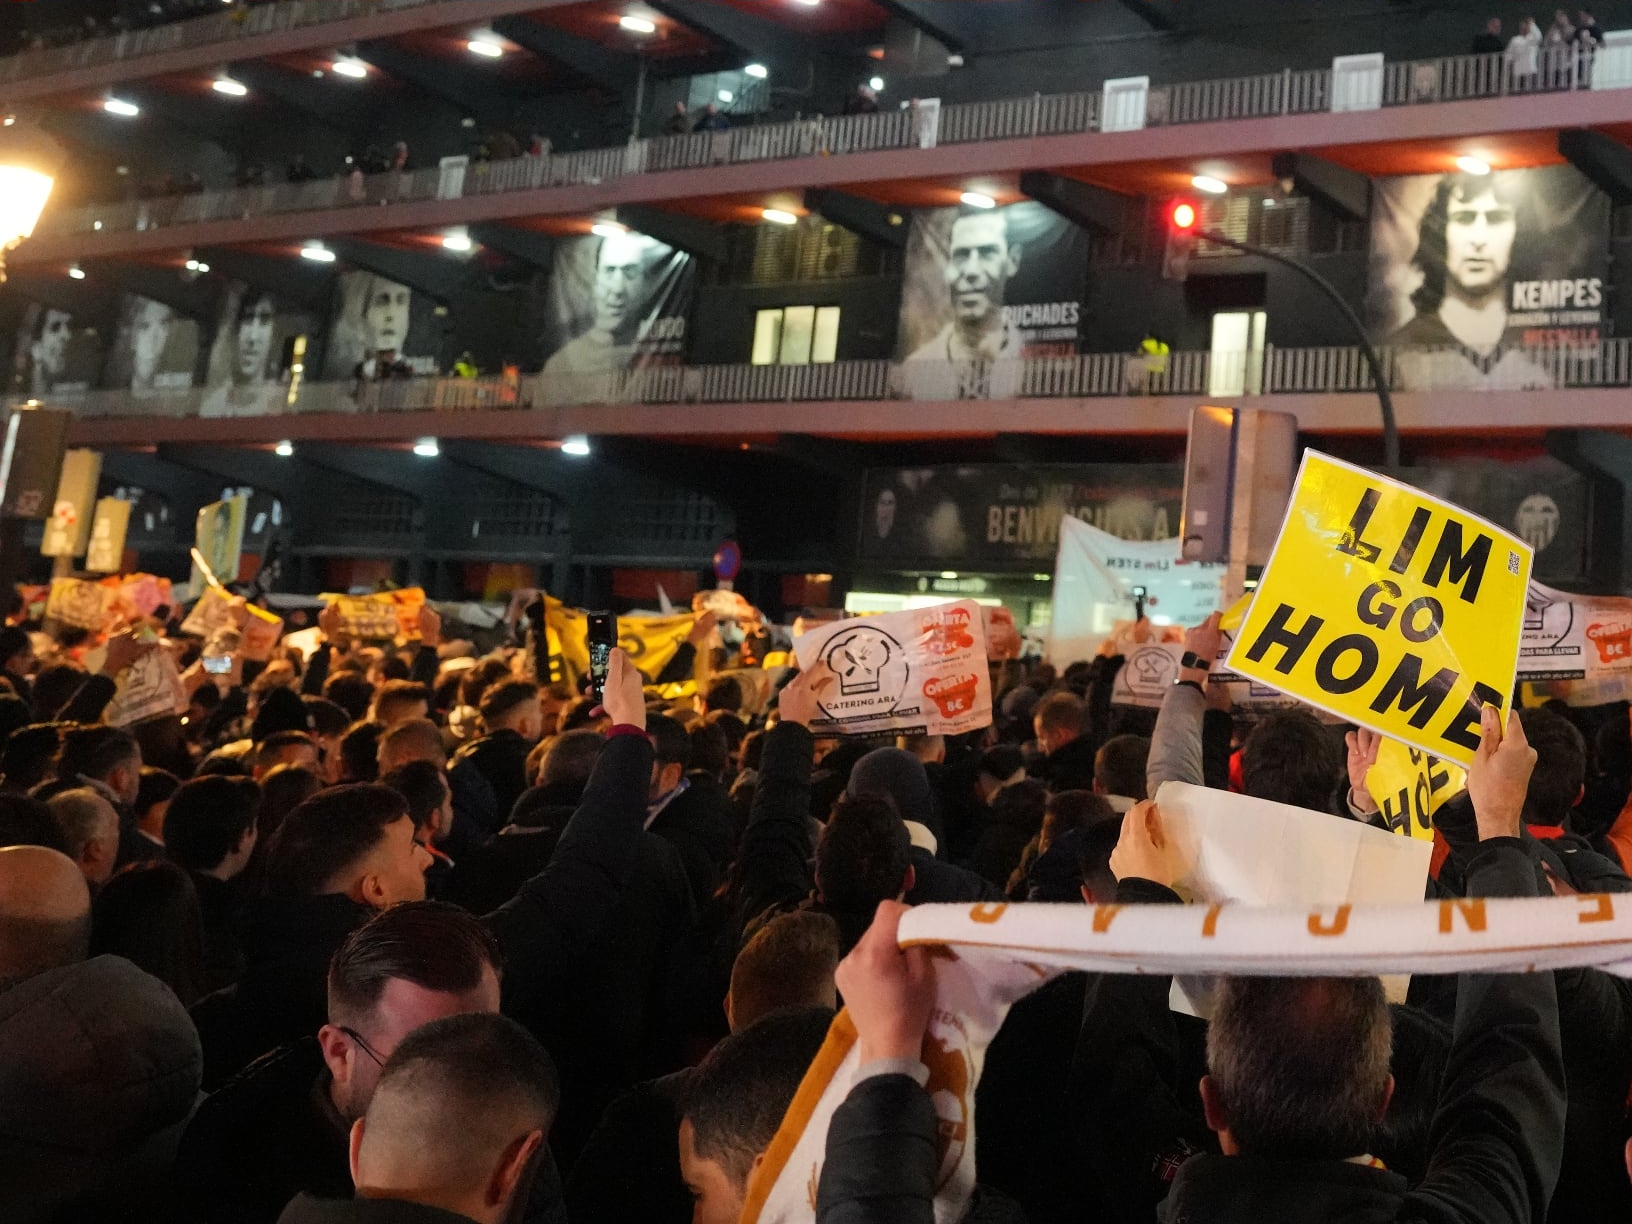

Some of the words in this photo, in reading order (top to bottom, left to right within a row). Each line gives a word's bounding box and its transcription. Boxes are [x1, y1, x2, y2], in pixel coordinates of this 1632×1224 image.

[1511, 278, 1602, 310] KEMPES
[1336, 488, 1493, 605] LIM
[1356, 579, 1445, 643] GO
[1606, 643, 1625, 656] 8€
[1245, 602, 1504, 752] HOME
[826, 697, 875, 711] CATERING
[876, 695, 897, 705] ARA
[946, 697, 964, 712] 8€
